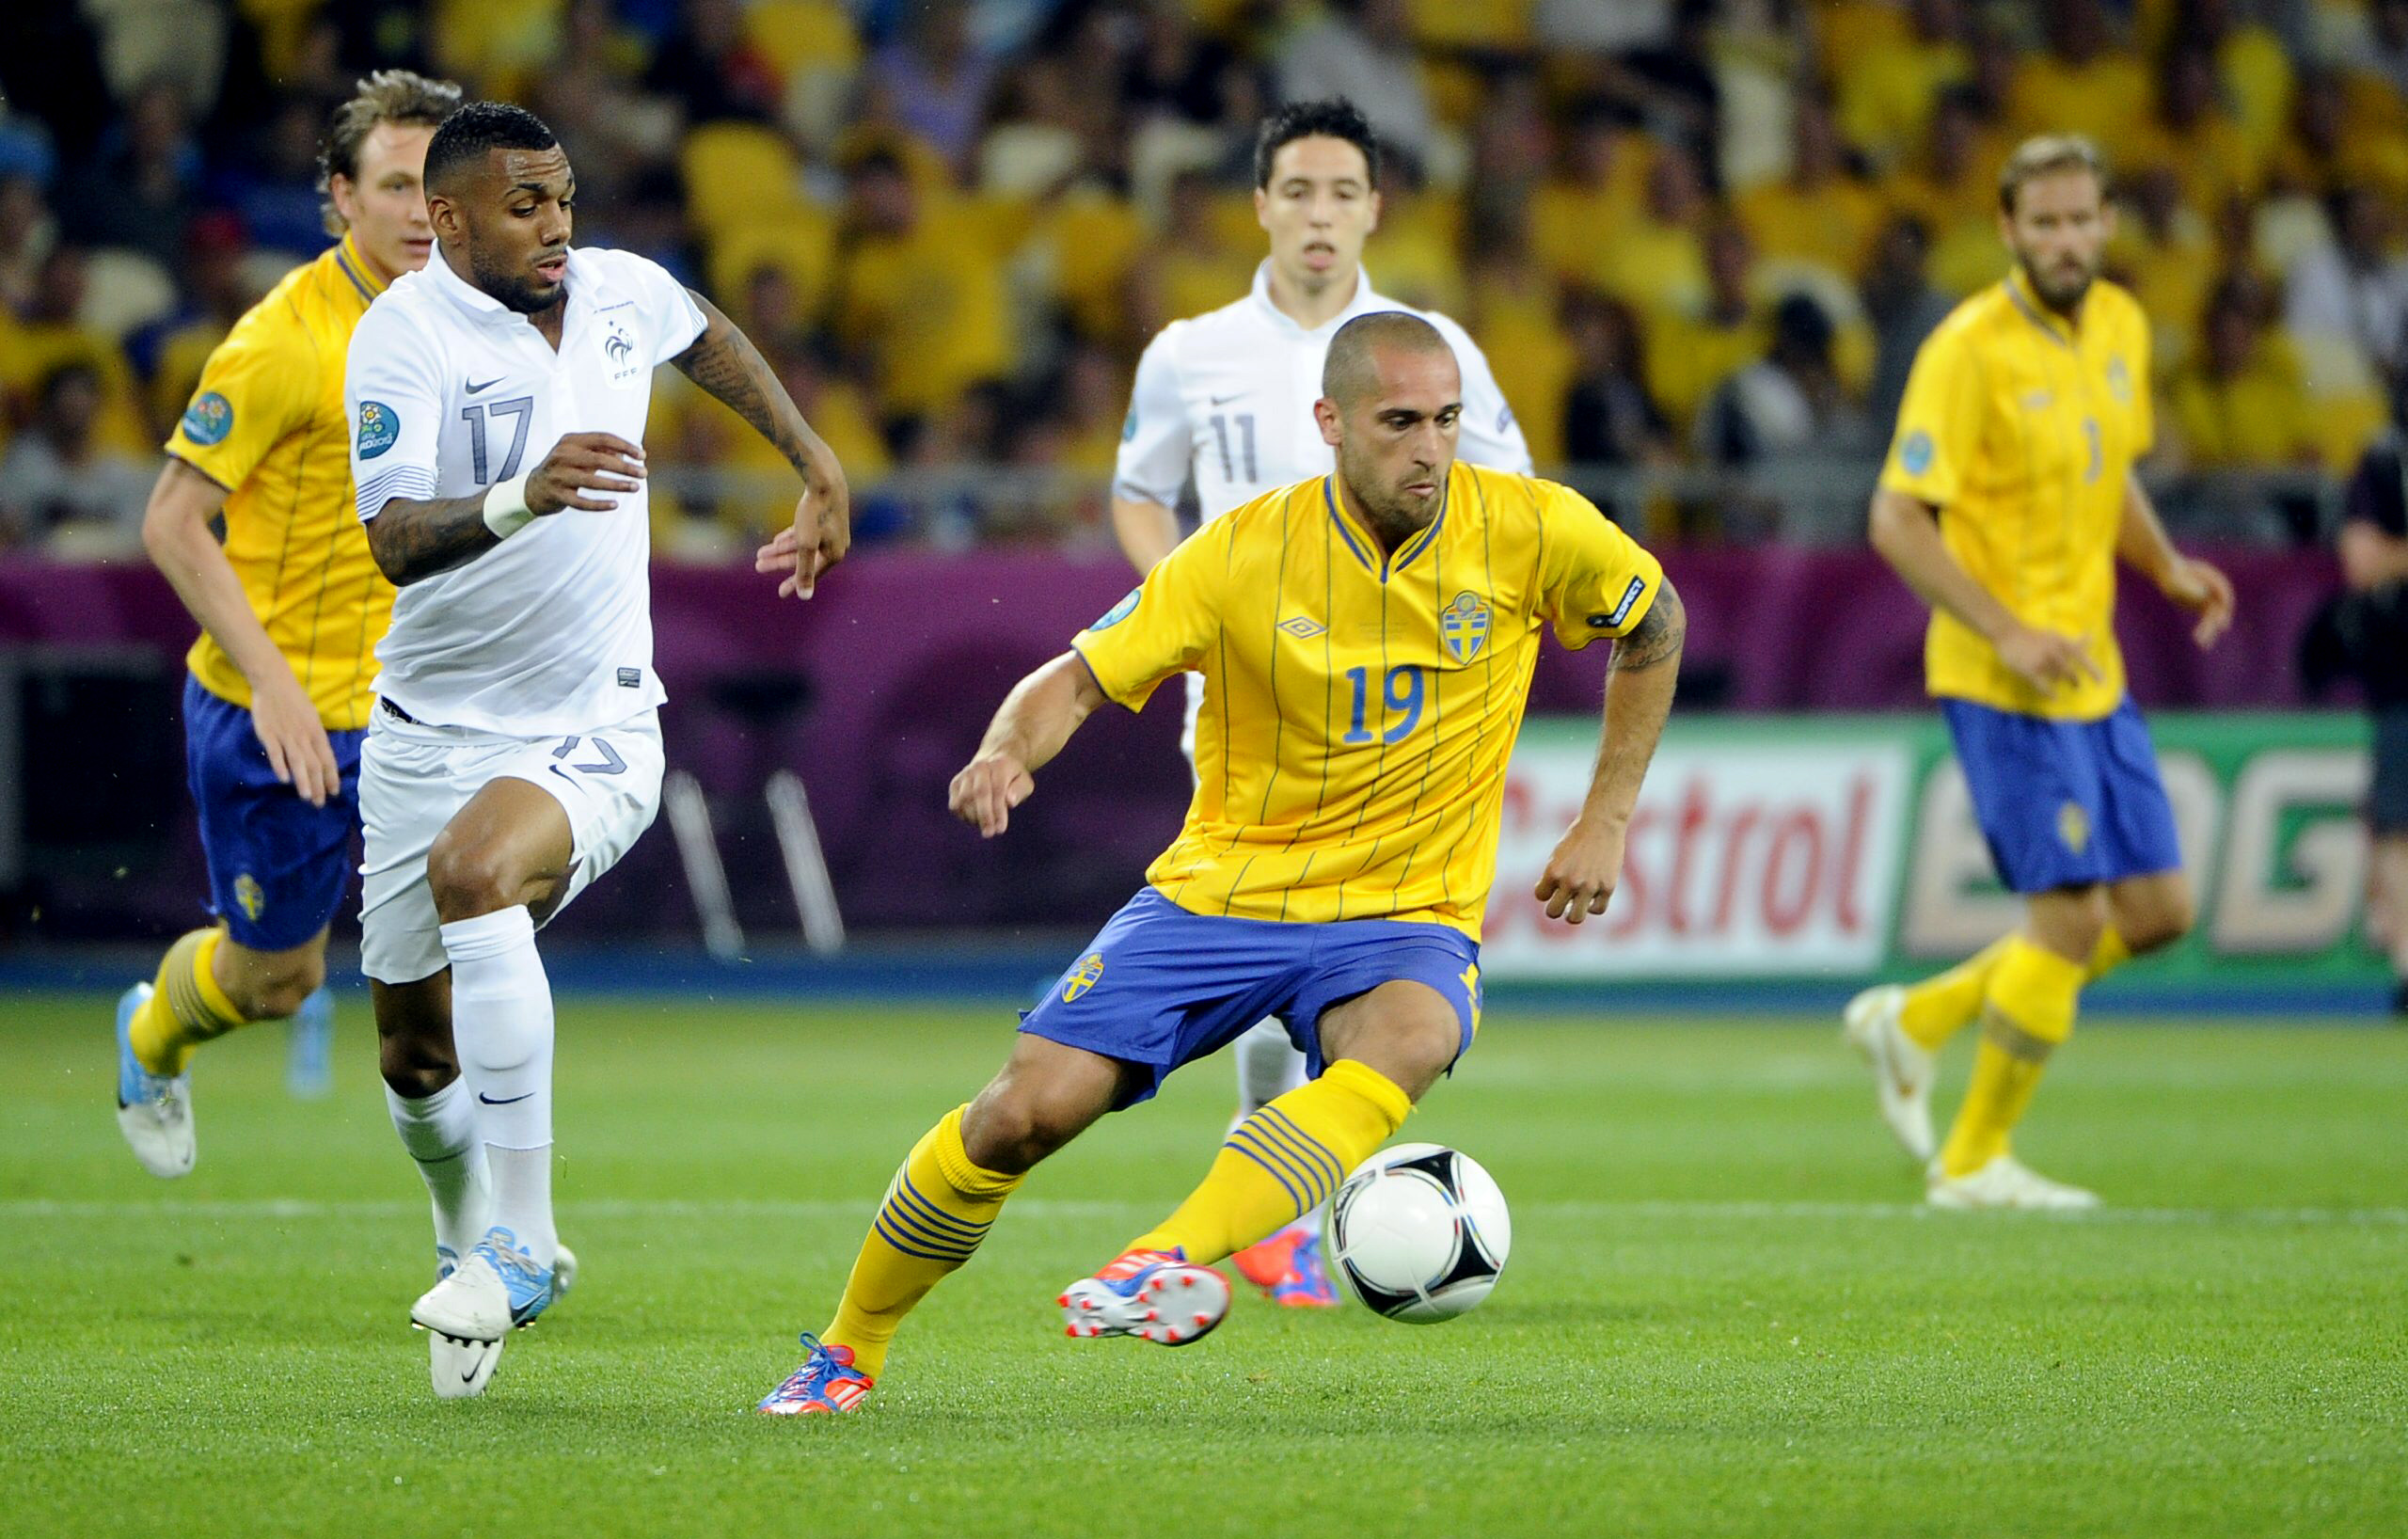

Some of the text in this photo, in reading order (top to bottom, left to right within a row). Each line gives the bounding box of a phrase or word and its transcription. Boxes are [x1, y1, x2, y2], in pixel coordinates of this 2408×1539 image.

[462, 396, 534, 484] 17
[1209, 415, 1258, 484] 11
[1342, 664, 1425, 745] 19
